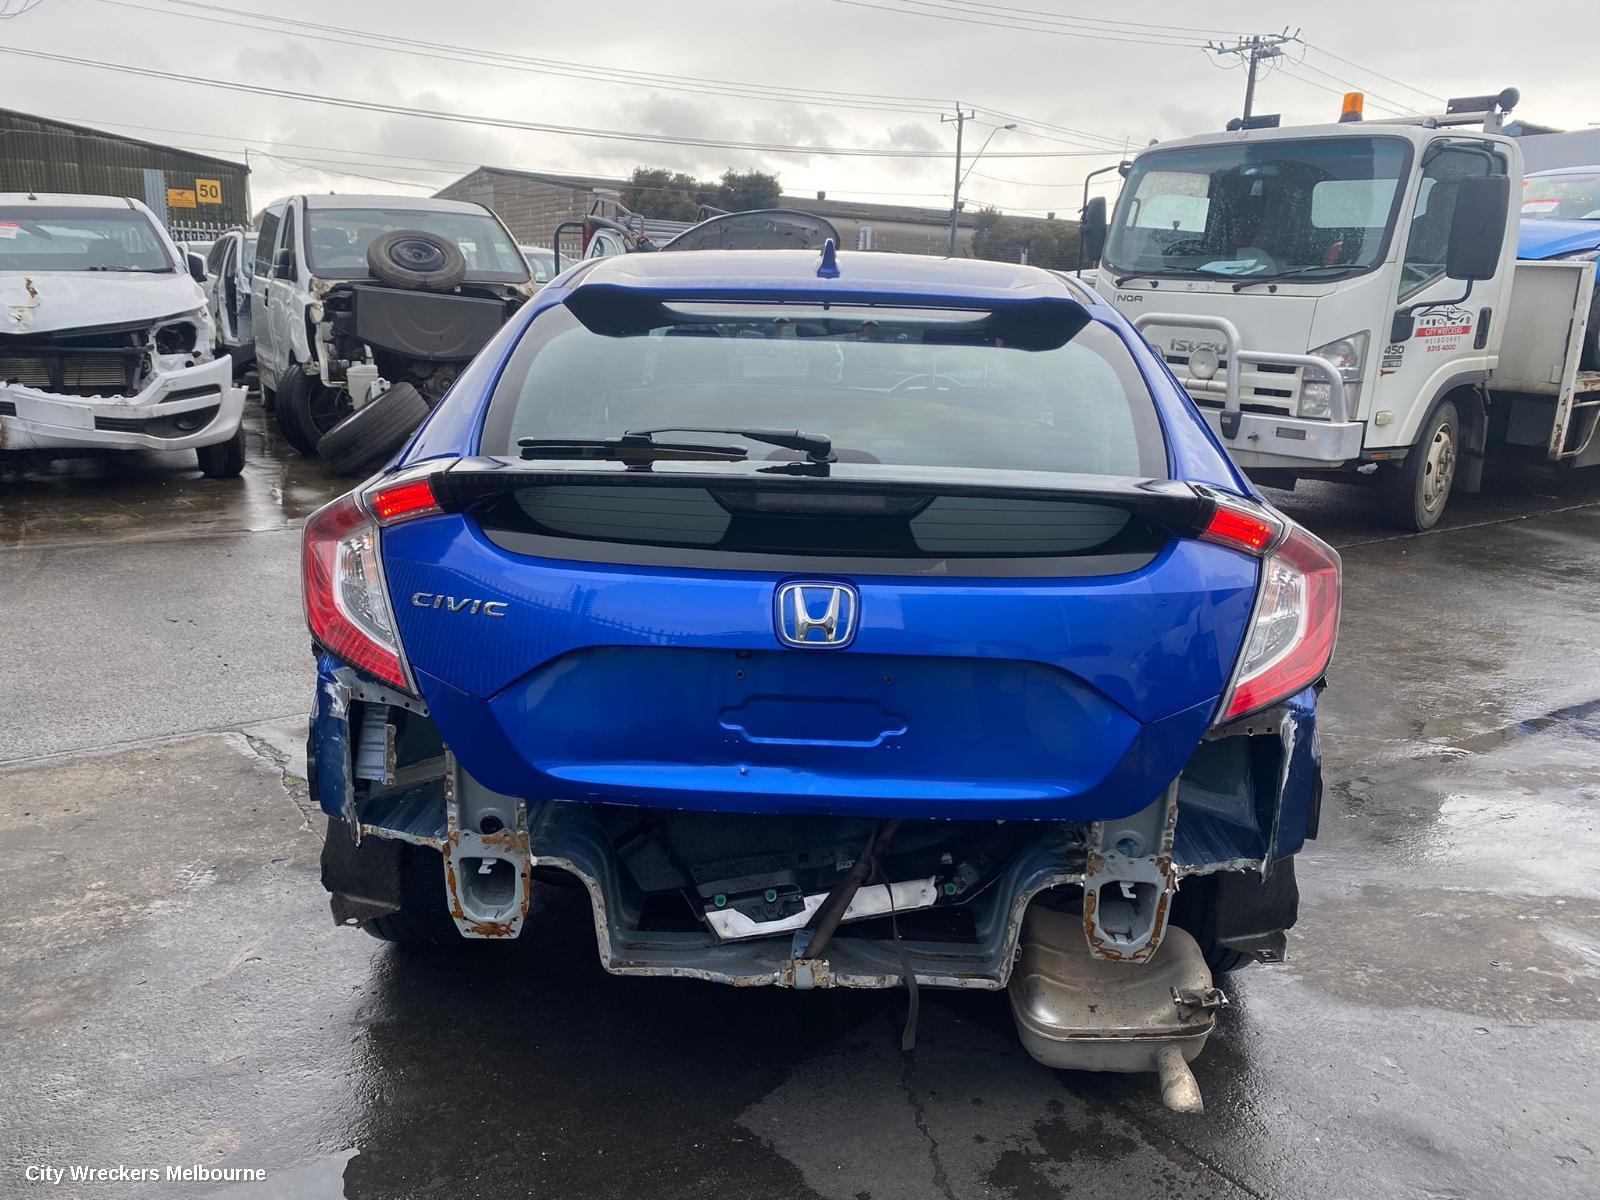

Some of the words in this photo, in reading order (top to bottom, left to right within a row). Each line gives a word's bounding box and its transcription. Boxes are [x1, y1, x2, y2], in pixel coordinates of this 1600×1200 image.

[199, 184, 219, 198] 50
[1424, 328, 1436, 336] CITY
[1437, 326, 1463, 335] WRECKERS
[1425, 336, 1461, 344] MELBOURNE
[1384, 345, 1405, 354] 450
[411, 592, 509, 616] CIVIC
